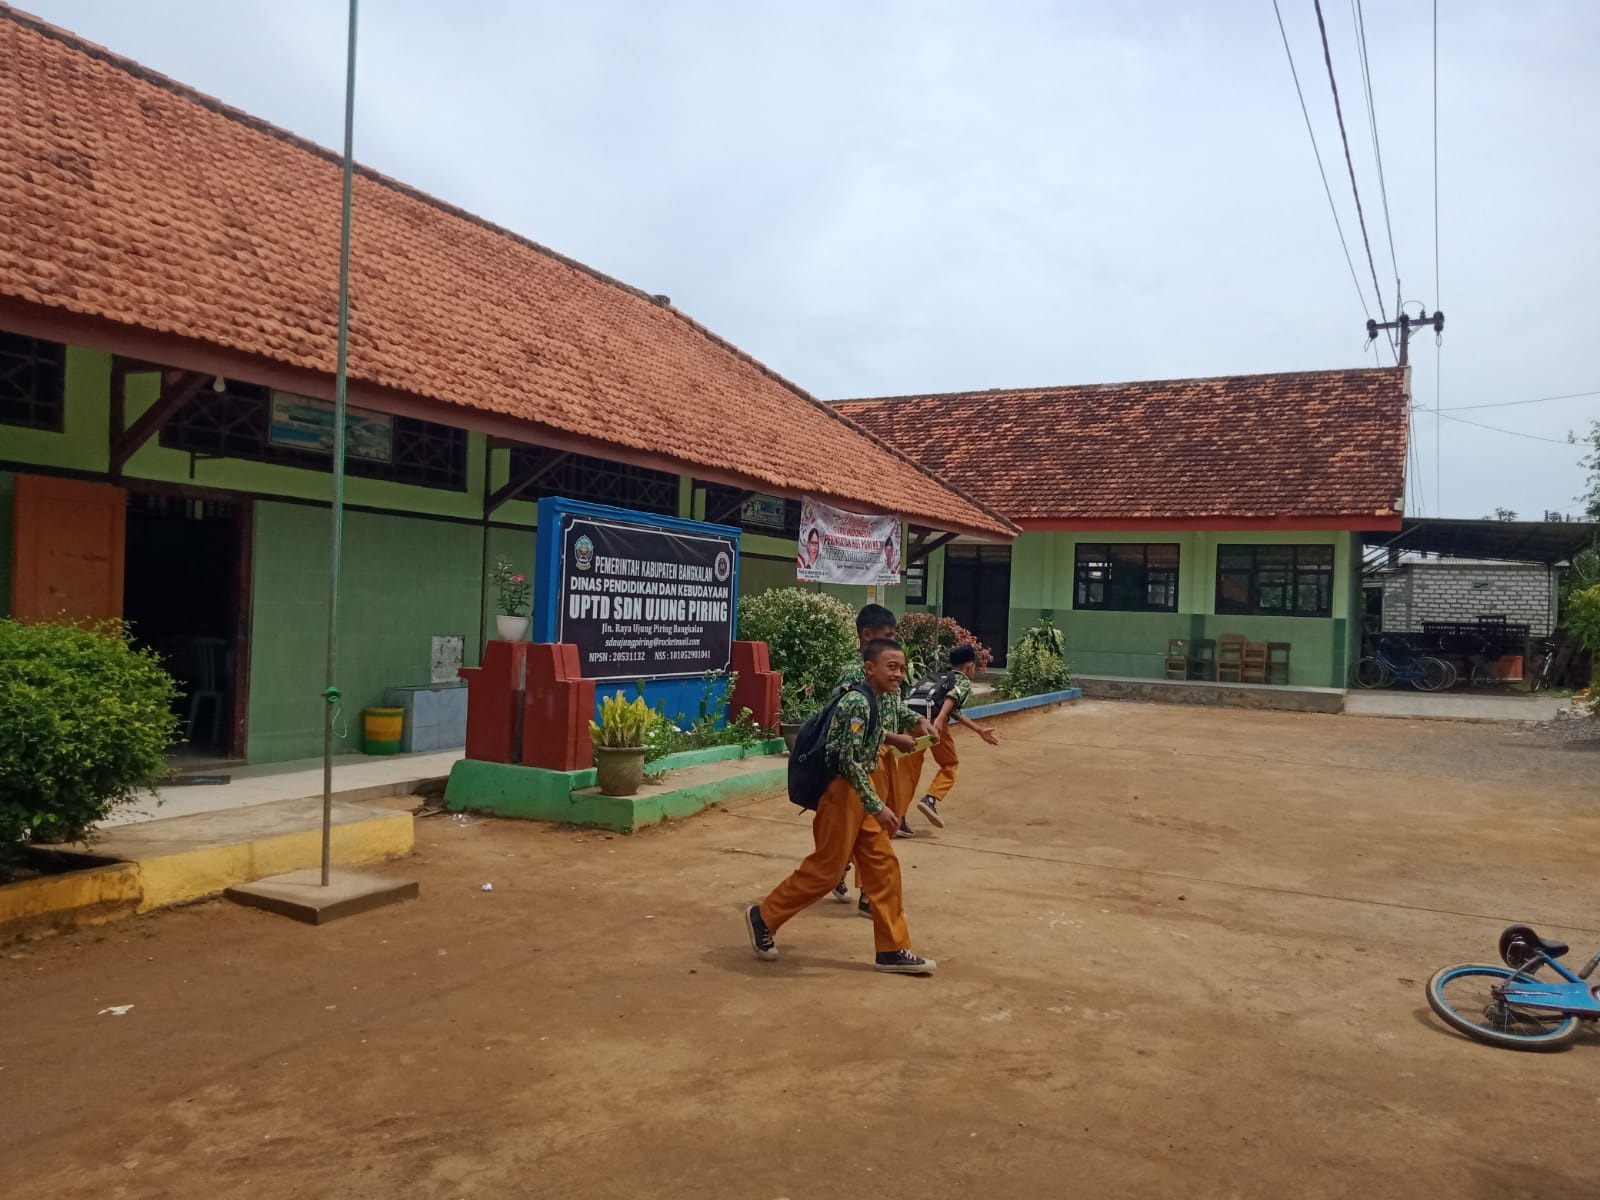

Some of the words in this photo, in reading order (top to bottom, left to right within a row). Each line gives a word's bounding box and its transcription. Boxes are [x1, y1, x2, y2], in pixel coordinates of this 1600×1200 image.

[595, 556, 640, 576] PEMERINTAH
[641, 560, 678, 580] KABUPATEN
[678, 564, 713, 582] BANGKALAN
[570, 576, 602, 592] DINAS
[603, 578, 658, 595] PENDIDIKAN
[659, 582, 677, 596] DAN
[677, 584, 729, 599] KEBUDAYAAN
[569, 594, 610, 620] UPTD
[613, 596, 643, 621] SDN
[645, 598, 686, 622] UJUNG
[688, 600, 728, 622] PIRING
[615, 624, 632, 635] Raya
[633, 624, 653, 635] Ujung
[653, 624, 673, 635] Piring
[673, 624, 704, 635] Bangkalan
